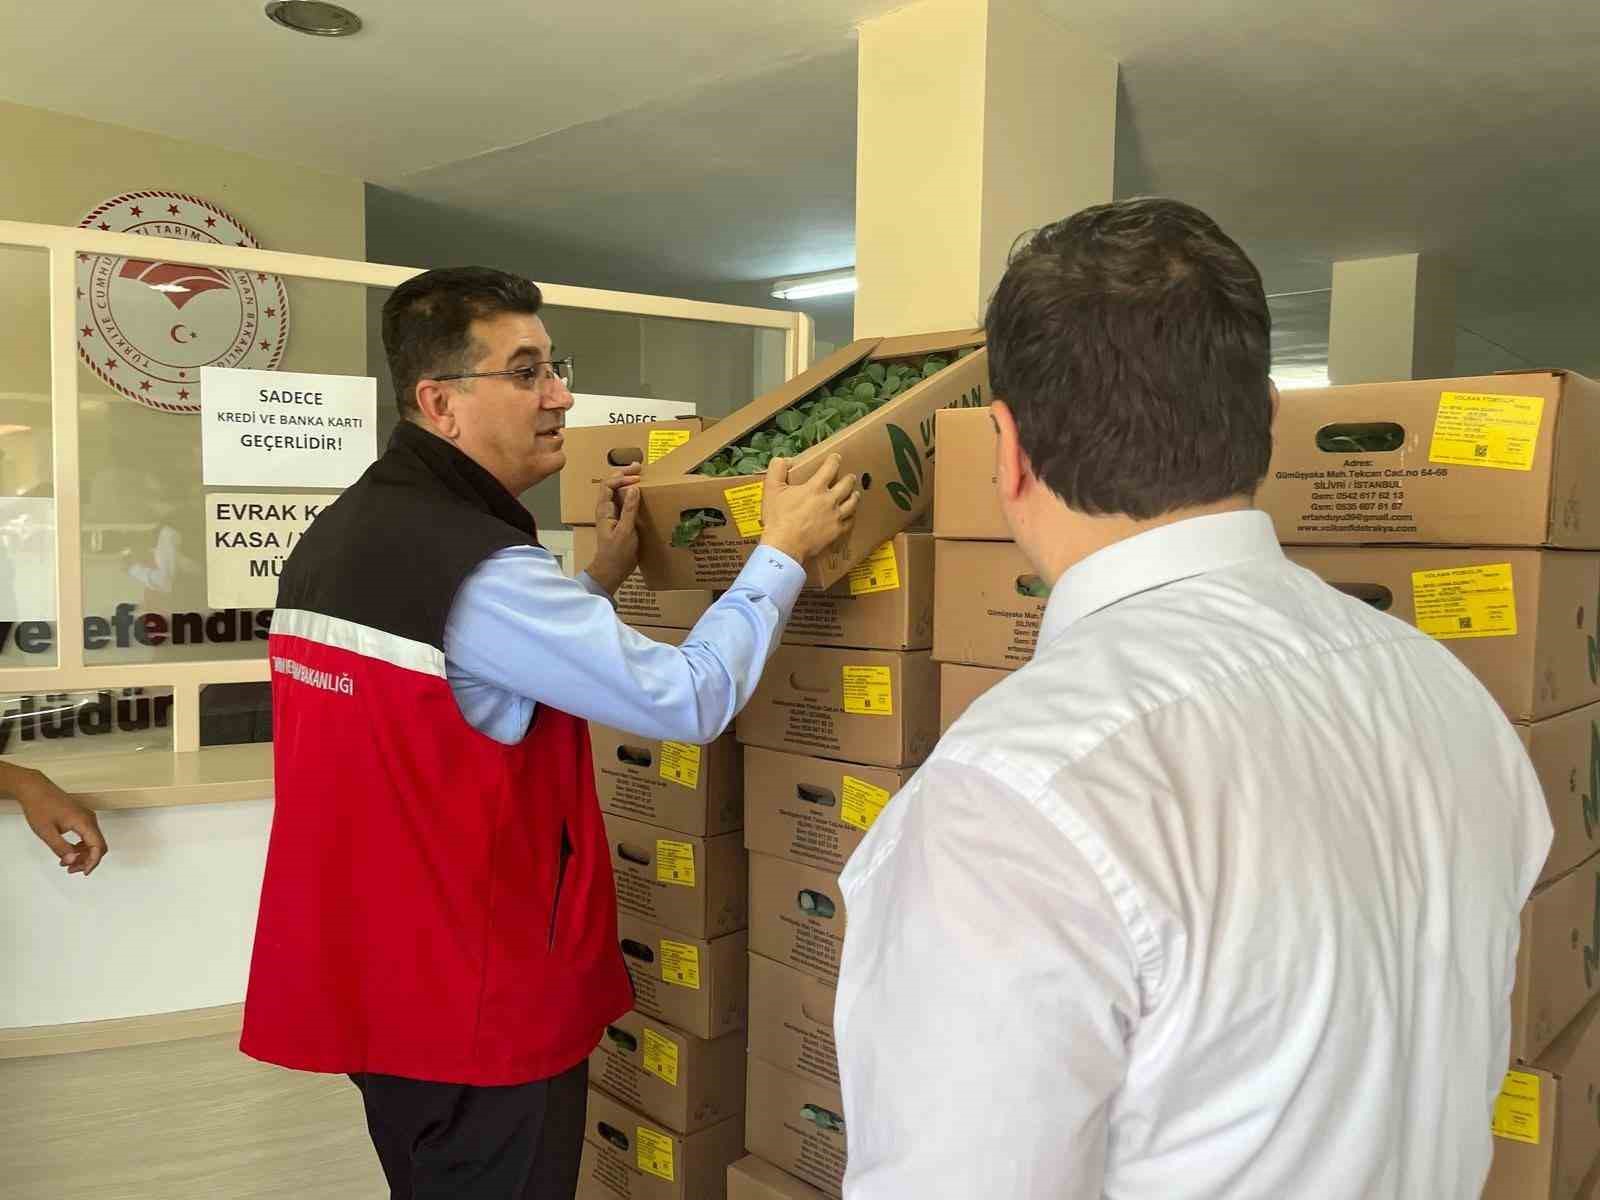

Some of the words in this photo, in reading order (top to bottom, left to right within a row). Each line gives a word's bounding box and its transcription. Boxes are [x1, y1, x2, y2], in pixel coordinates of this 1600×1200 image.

[155, 225, 200, 241] TARIM
[260, 389, 323, 405] SADECE
[217, 411, 256, 423] KREDİ
[260, 414, 276, 424] VE
[280, 415, 324, 426] BANKA
[328, 417, 362, 428] KARTI
[240, 433, 342, 451] GEÇERLİDİR!
[217, 504, 296, 520] EVRAK
[305, 505, 319, 520] K
[215, 532, 280, 547] KASA
[287, 532, 293, 548] /
[250, 556, 284, 577] MÜ
[83, 603, 272, 650] efendis
